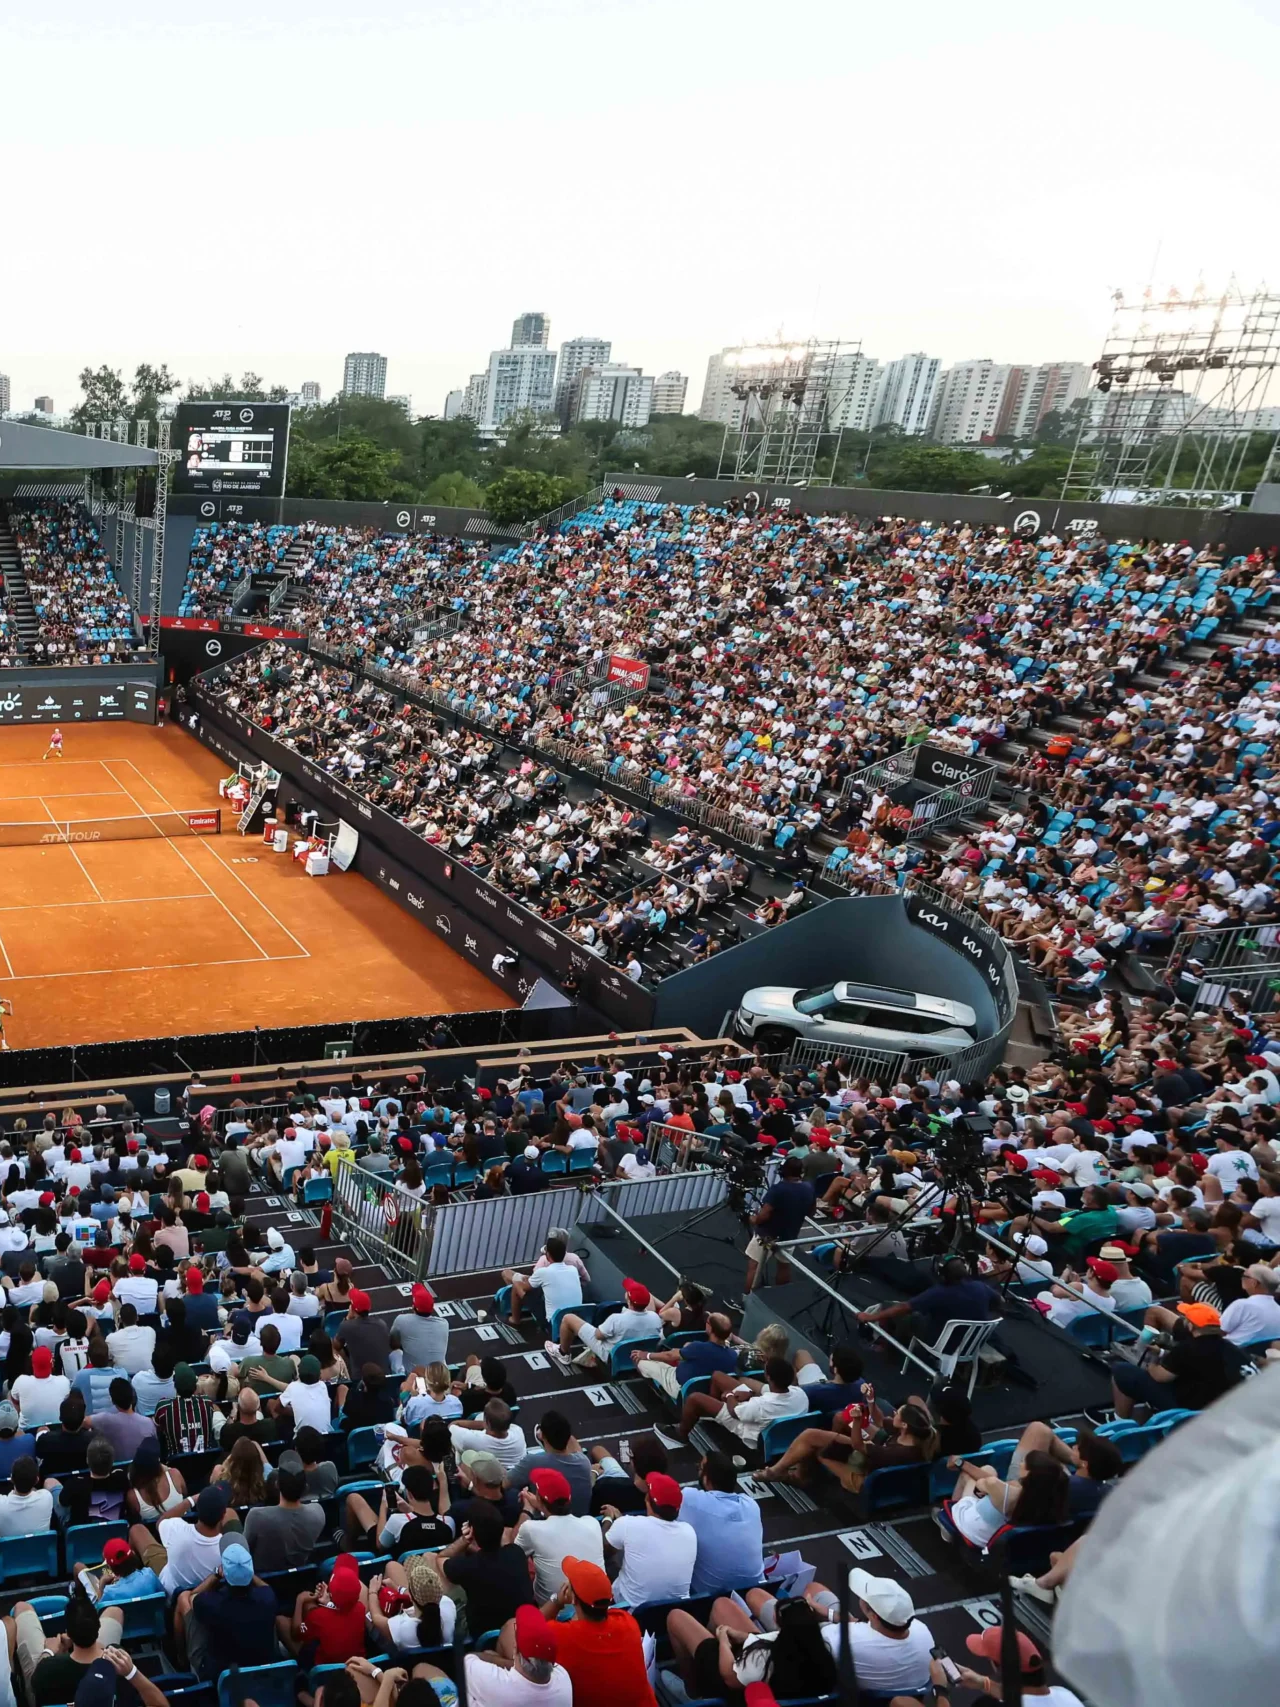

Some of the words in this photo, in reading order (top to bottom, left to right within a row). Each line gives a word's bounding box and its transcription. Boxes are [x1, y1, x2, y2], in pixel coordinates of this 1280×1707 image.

[212, 410, 231, 418] ATP
[771, 497, 791, 507] ATP
[1064, 519, 1098, 531] ATP
[611, 667, 628, 678] FINAL
[932, 761, 977, 781] Claro
[189, 817, 216, 825] Emirates
[68, 831, 100, 842] TOUR
[407, 892, 424, 909] Claro
[464, 934, 477, 950] bet
[941, 1139, 947, 1147] 2
[591, 1390, 606, 1402] K
[188, 1422, 201, 1430] CANO
[180, 1435, 204, 1453] 14
[744, 1481, 766, 1493] M
[848, 1537, 871, 1553] N
[978, 1609, 1001, 1626] O
